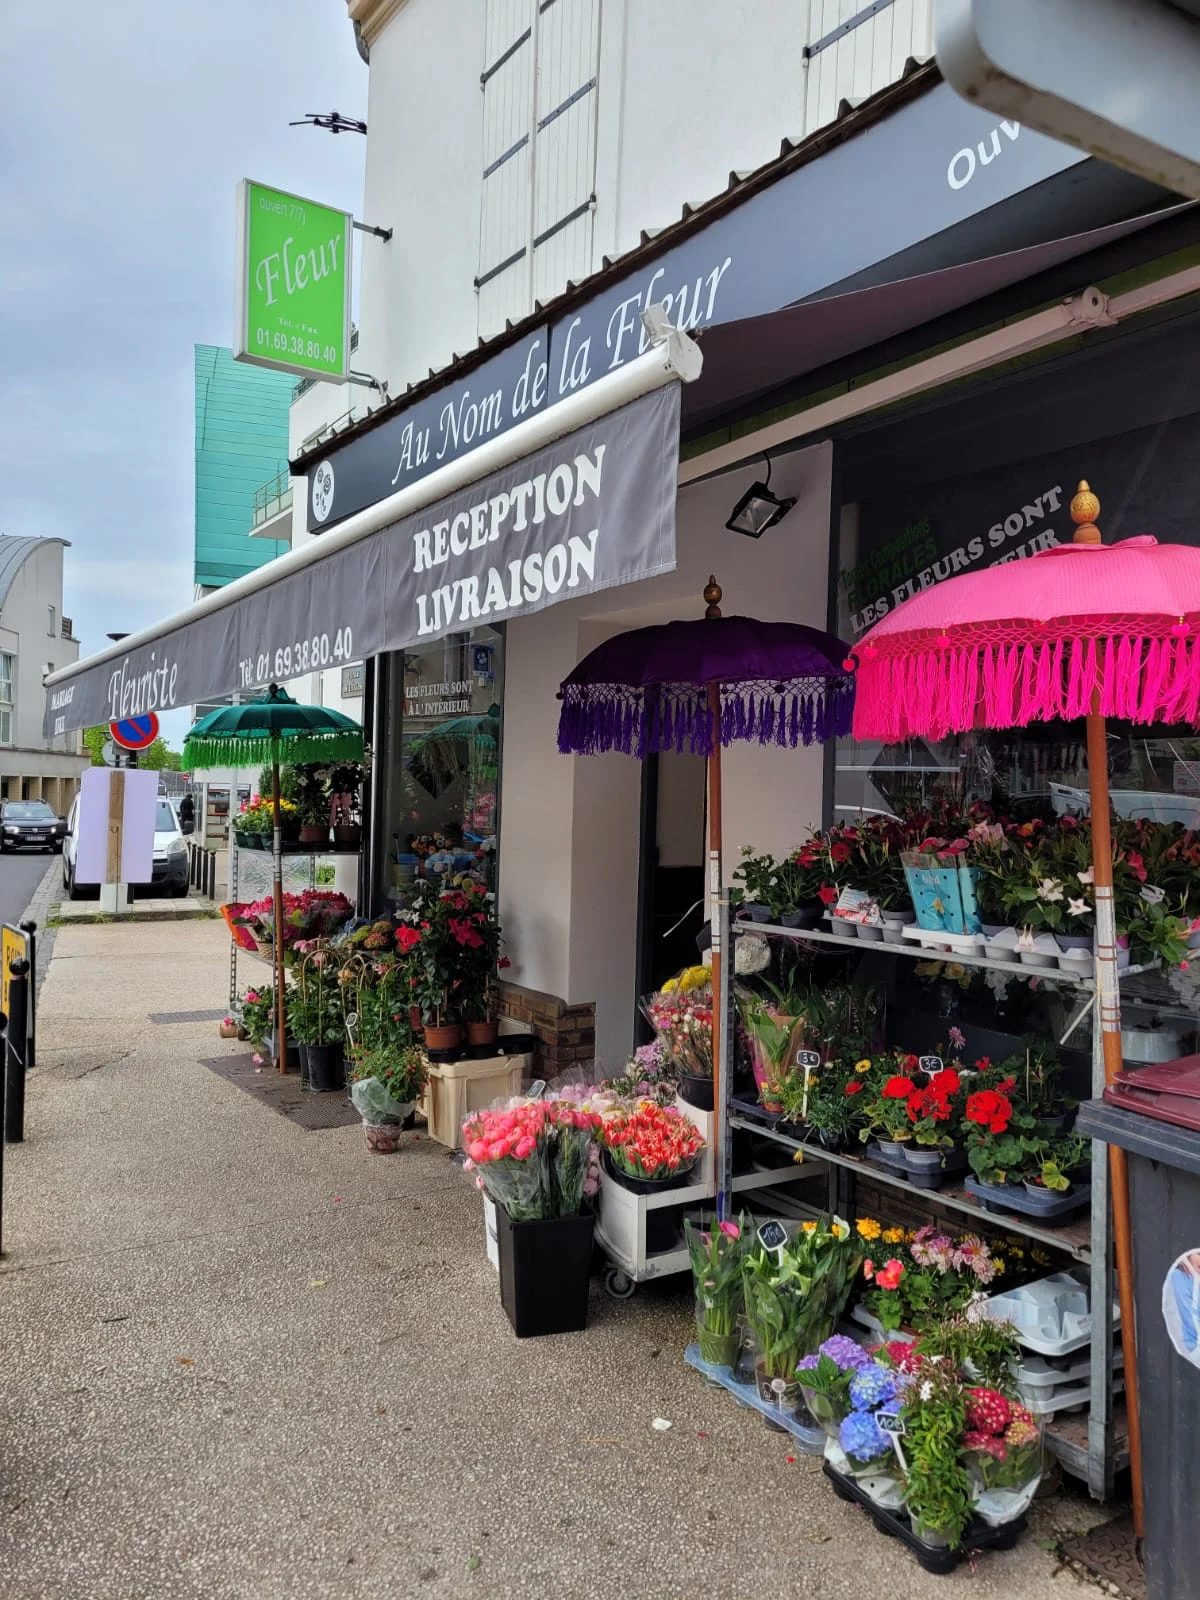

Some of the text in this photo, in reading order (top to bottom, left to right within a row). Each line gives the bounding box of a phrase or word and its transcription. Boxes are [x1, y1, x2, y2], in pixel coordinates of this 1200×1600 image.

[255, 233, 341, 306] Fleur
[256, 327, 336, 363] 01.69.38.80.40
[391, 420, 430, 485] Au
[436, 390, 503, 460] Nom
[511, 339, 549, 418] de
[558, 317, 593, 394] la
[413, 444, 606, 573] RECEPTION
[416, 529, 599, 635] LIVRAISON
[849, 597, 890, 634] LES
[891, 536, 985, 606] FLEURS
[987, 485, 1062, 548] SONT
[108, 652, 178, 720] Fleuriste
[256, 626, 353, 682] 01.69.38.80.40
[405, 680, 474, 698] LES FLEURS SONT
